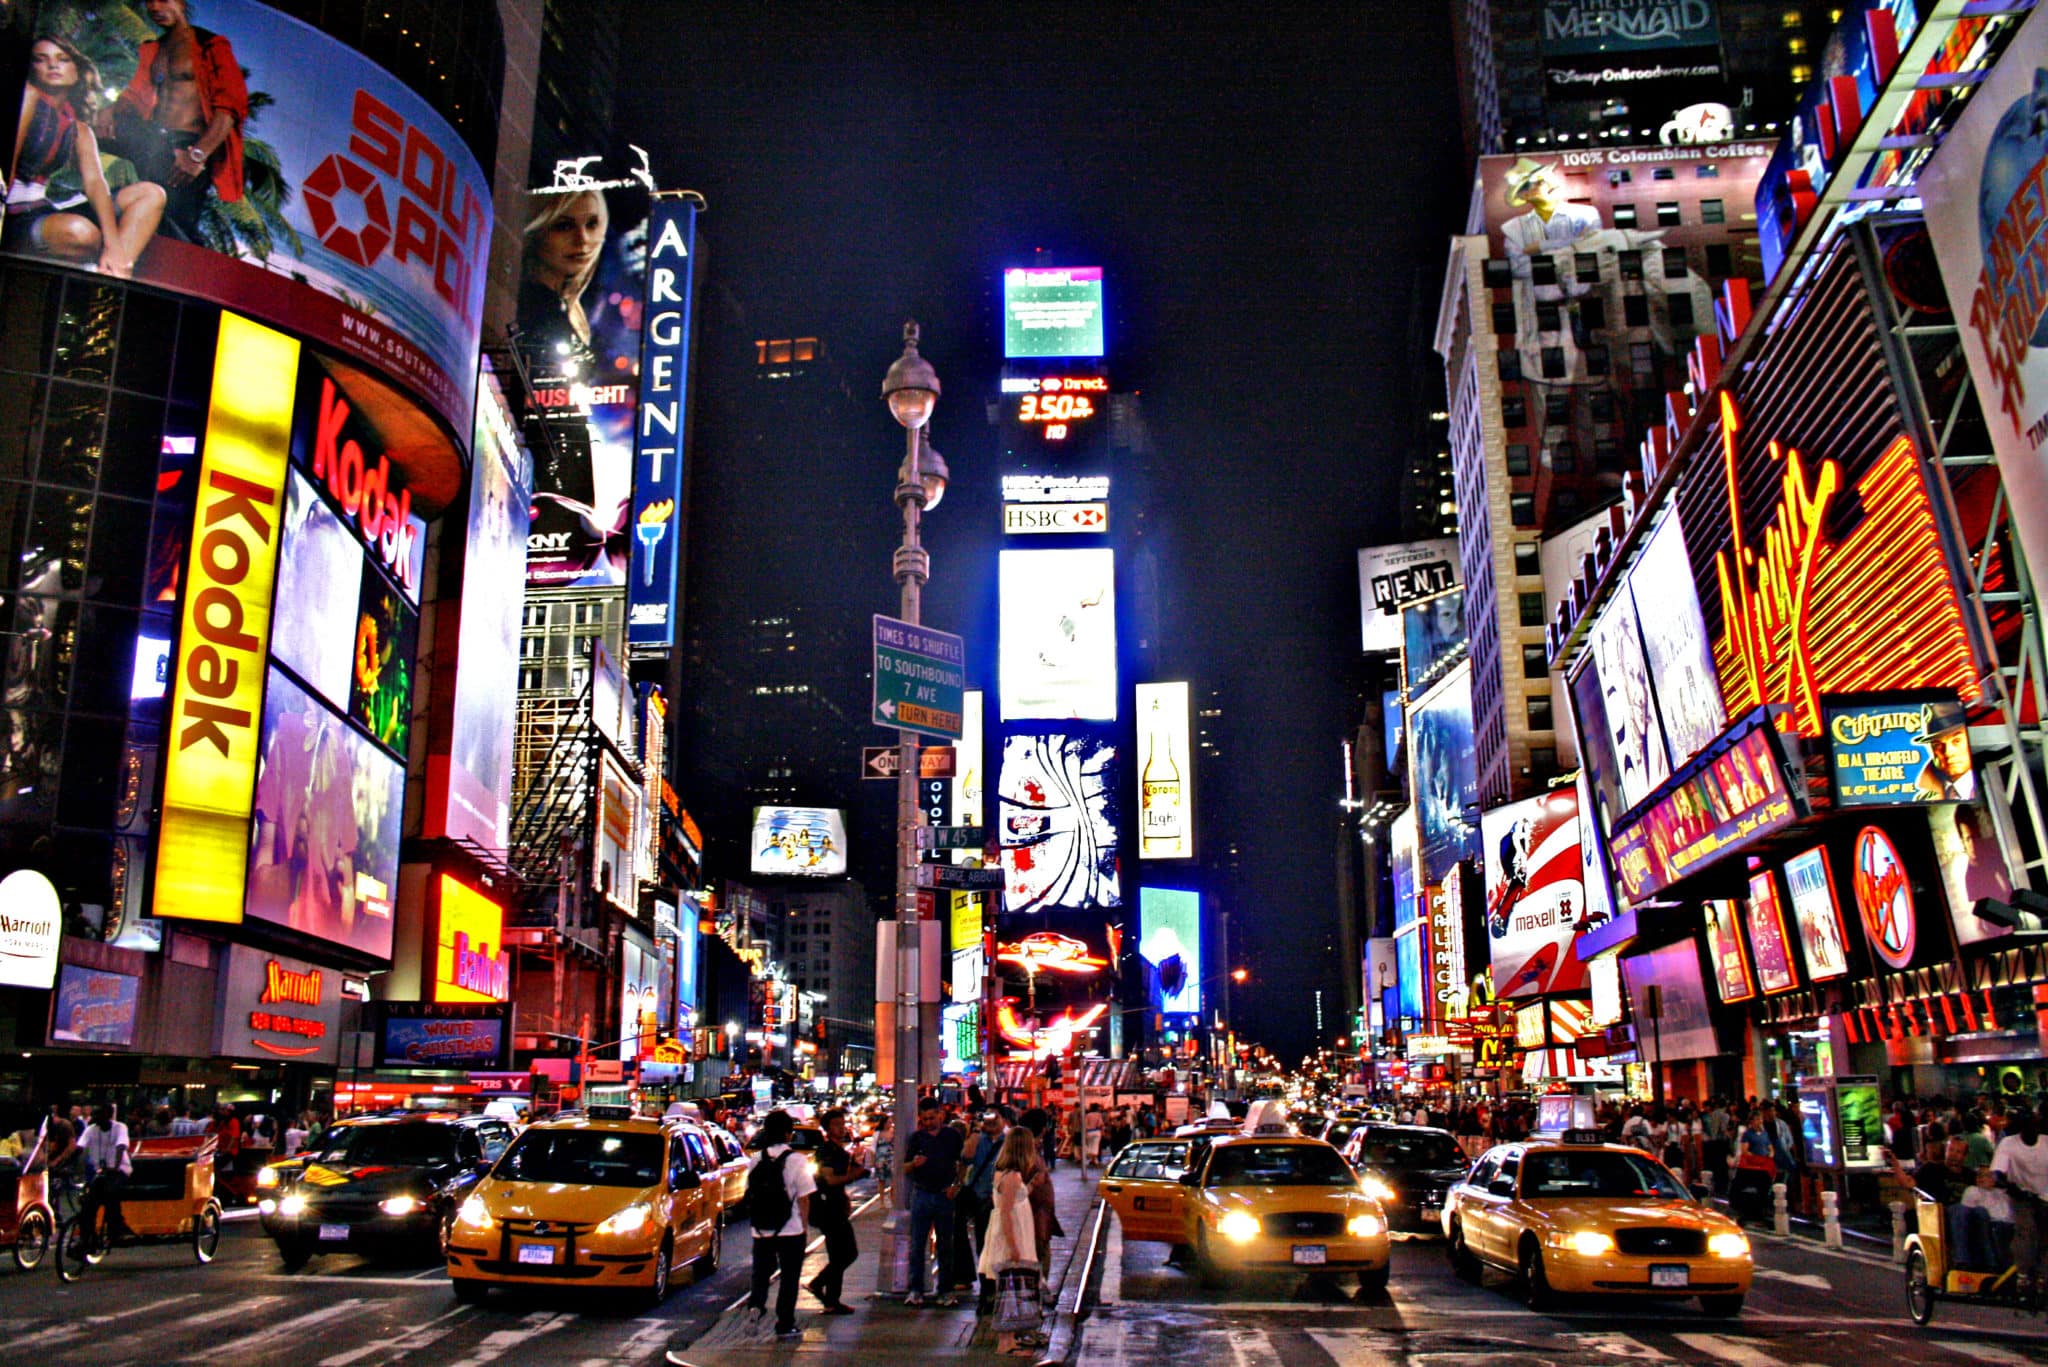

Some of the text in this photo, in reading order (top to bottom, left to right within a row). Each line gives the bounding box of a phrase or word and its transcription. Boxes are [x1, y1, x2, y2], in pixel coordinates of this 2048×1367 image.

[1544, 0, 1710, 40] MERMAID
[1563, 145, 1765, 166] 100% Colombian Coffee
[641, 218, 688, 482] ARGENT
[313, 378, 417, 590] Kodak
[1008, 510, 1066, 527] HSBC
[1374, 566, 1447, 602] RENT
[179, 470, 275, 759] Kodak
[878, 626, 961, 659] TIMES SQ SHUFFLE
[878, 654, 961, 688] TO SOUTHBOUND
[904, 682, 936, 702] 7 AVE
[900, 704, 959, 731] TURN HERE
[1862, 766, 1906, 781] THEATRE
[929, 781, 943, 859] OVOTL
[938, 829, 948, 846] W
[952, 829, 967, 846] 45
[935, 867, 1003, 882] GEORGE ABBOTT
[1515, 908, 1556, 933] maxell
[1433, 895, 1450, 1002] PALACE
[261, 960, 322, 1006] Marriott
[423, 1021, 473, 1037] WHITE
[406, 1035, 494, 1060] CHRISTMAS
